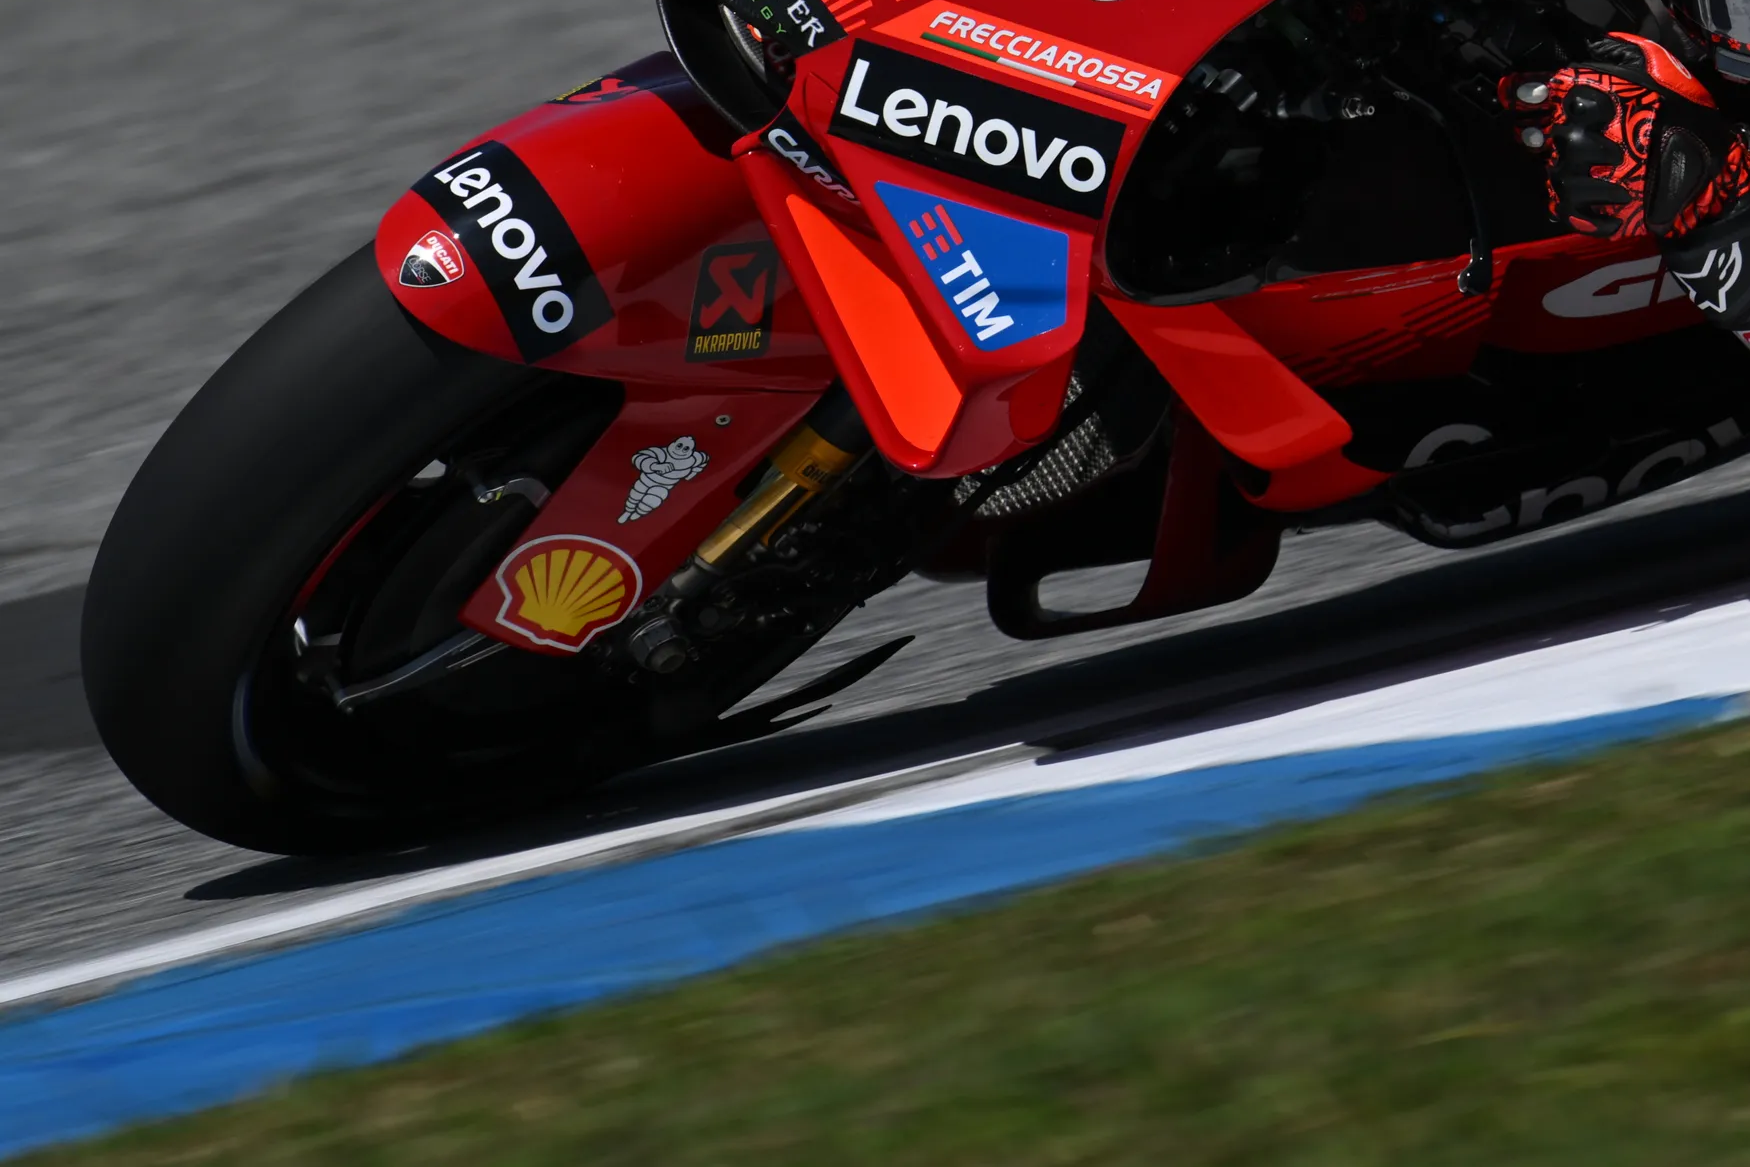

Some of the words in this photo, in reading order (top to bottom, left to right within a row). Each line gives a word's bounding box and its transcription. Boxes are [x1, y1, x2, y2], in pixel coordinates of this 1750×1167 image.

[929, 10, 1163, 101] FRECCIAROSSA
[839, 58, 1106, 193] Lenovo
[426, 235, 460, 275] DUCATI
[434, 152, 574, 334] Lenovo
[940, 250, 1015, 342] TIM
